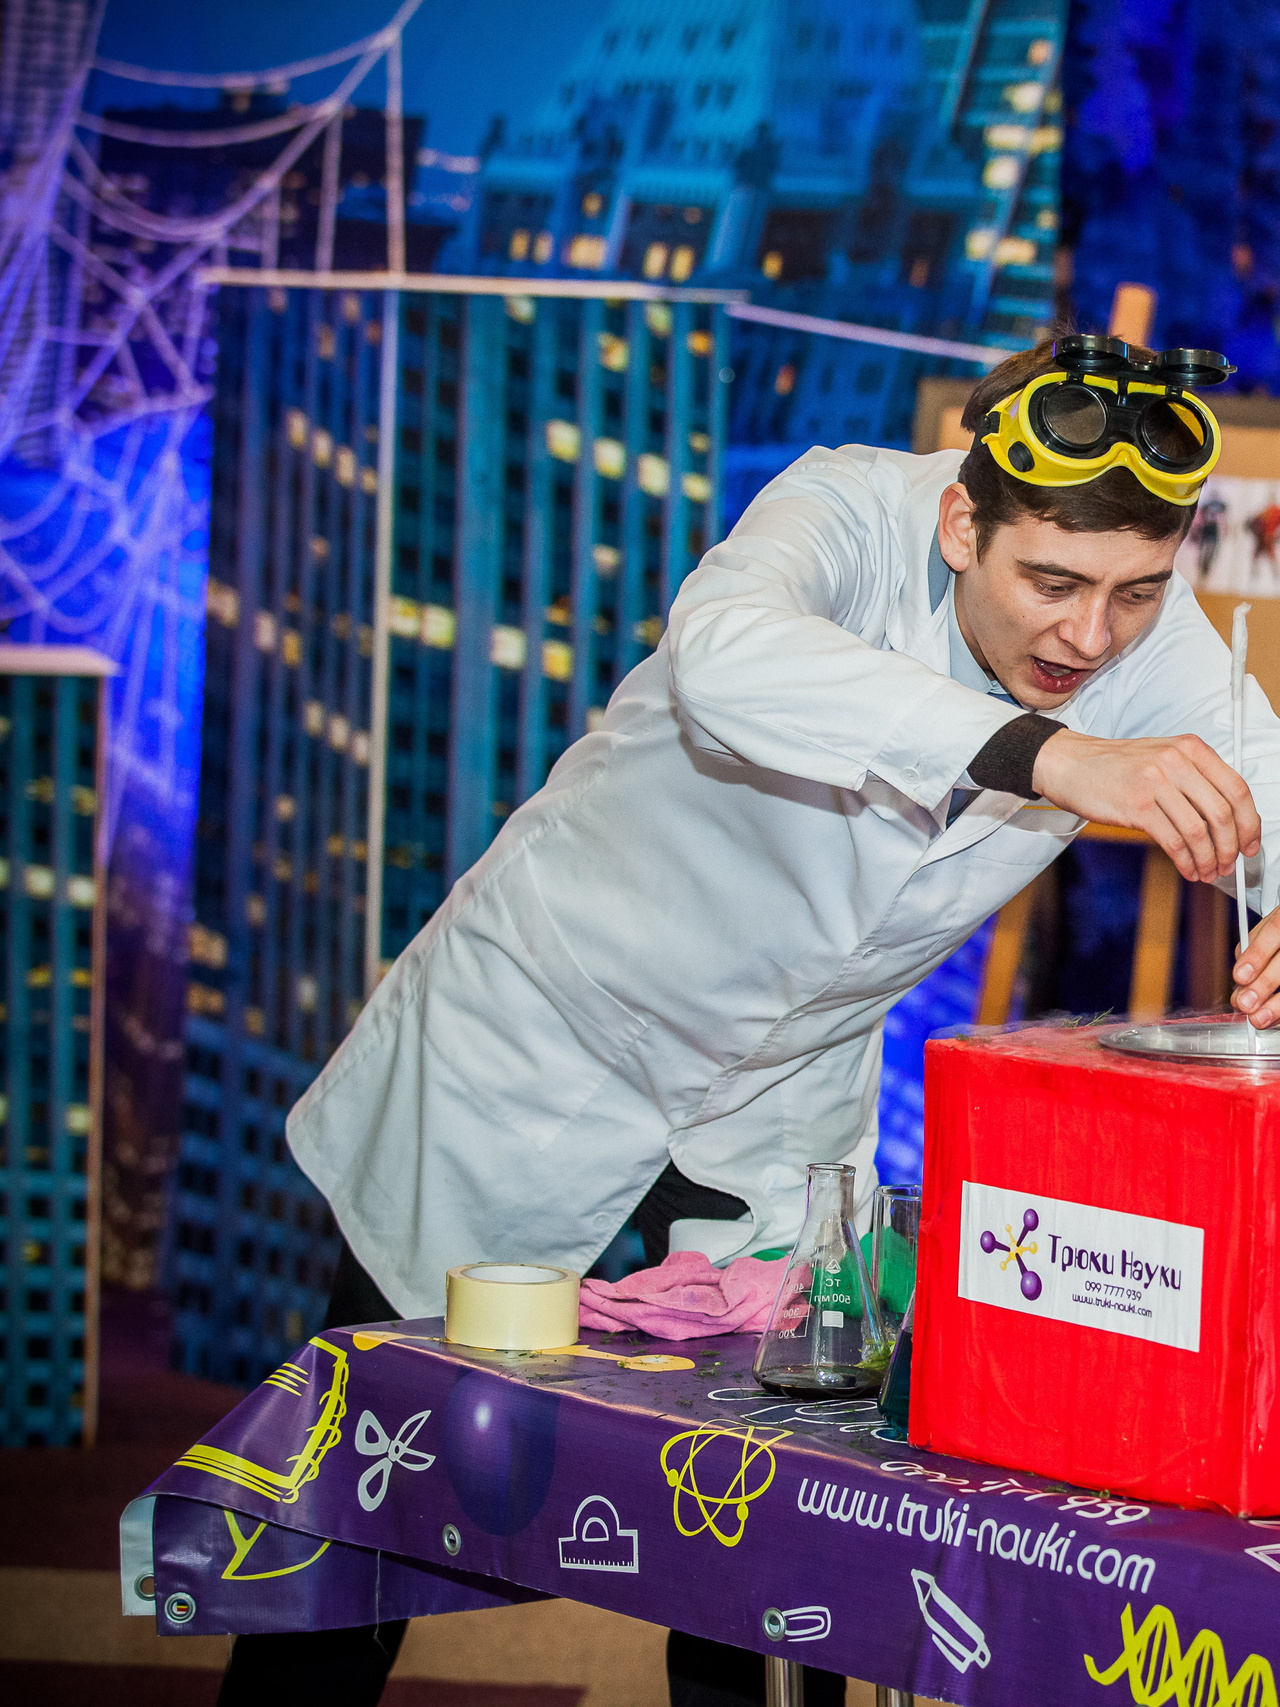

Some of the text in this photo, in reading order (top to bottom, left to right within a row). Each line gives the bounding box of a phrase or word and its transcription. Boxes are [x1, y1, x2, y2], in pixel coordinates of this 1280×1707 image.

[1048, 1234, 1182, 1290] Трюки Науки
[1085, 1280, 1142, 1302] 099 7777 939
[797, 1477, 1156, 1594] www.truki-nauki.com
